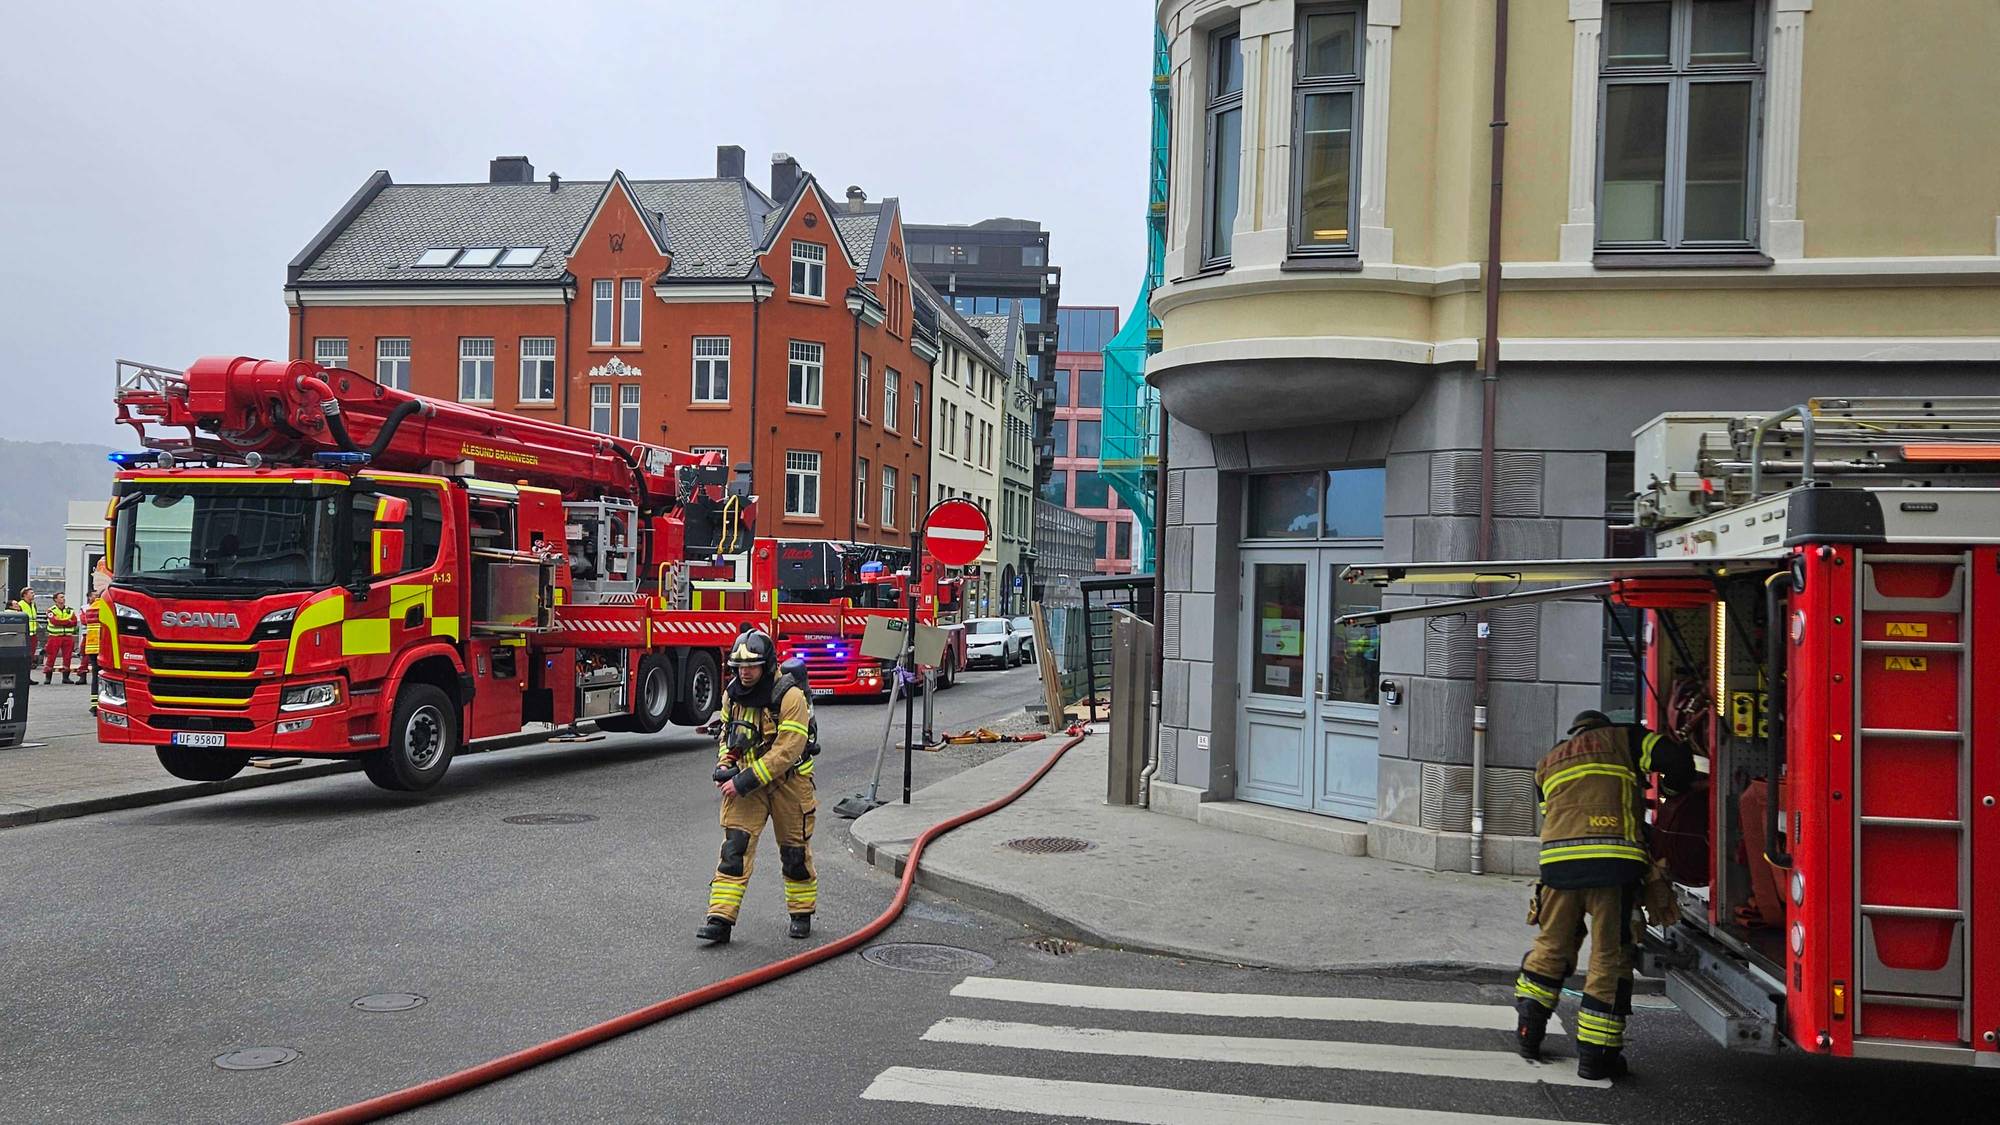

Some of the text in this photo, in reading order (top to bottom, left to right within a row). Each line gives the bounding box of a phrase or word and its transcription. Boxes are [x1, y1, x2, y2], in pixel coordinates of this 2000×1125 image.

[461, 440, 539, 465] ÅLESUND BRANNVESEN
[1015, 578, 1021, 586] P
[161, 611, 240, 628] SCANIA
[179, 734, 223, 745] UF 95807
[1589, 815, 1617, 827] KOS
